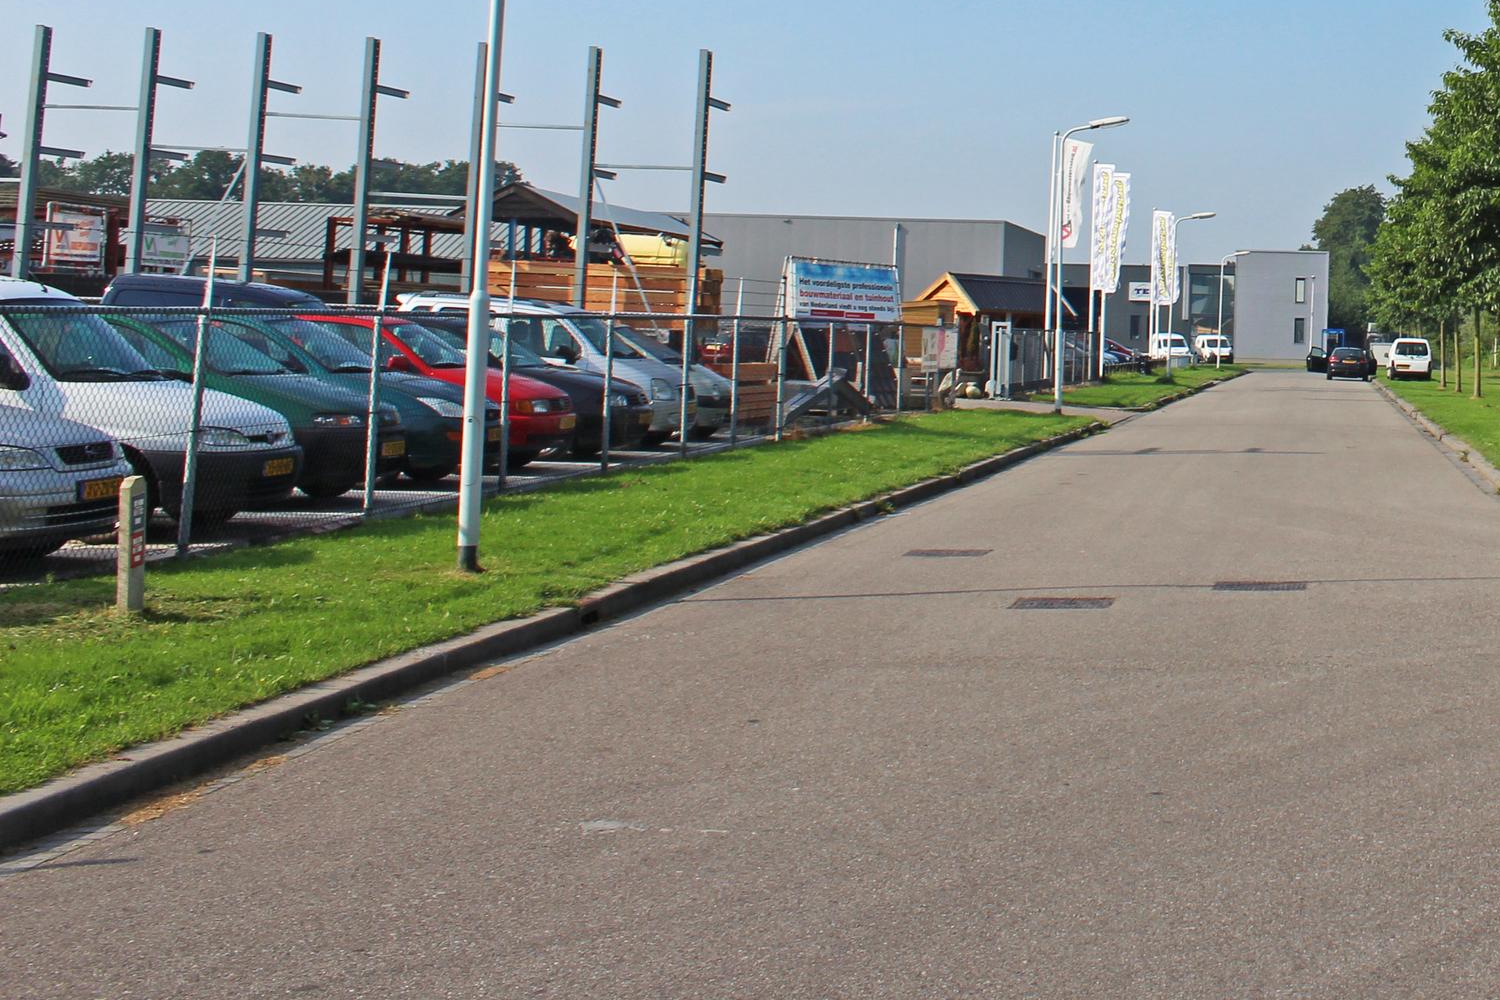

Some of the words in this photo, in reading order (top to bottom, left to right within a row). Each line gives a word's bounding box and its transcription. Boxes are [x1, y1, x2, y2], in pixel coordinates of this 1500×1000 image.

[799, 278, 811, 286] Het
[799, 289, 853, 300] bouwmateriaal
[865, 293, 894, 302] tuinhout
